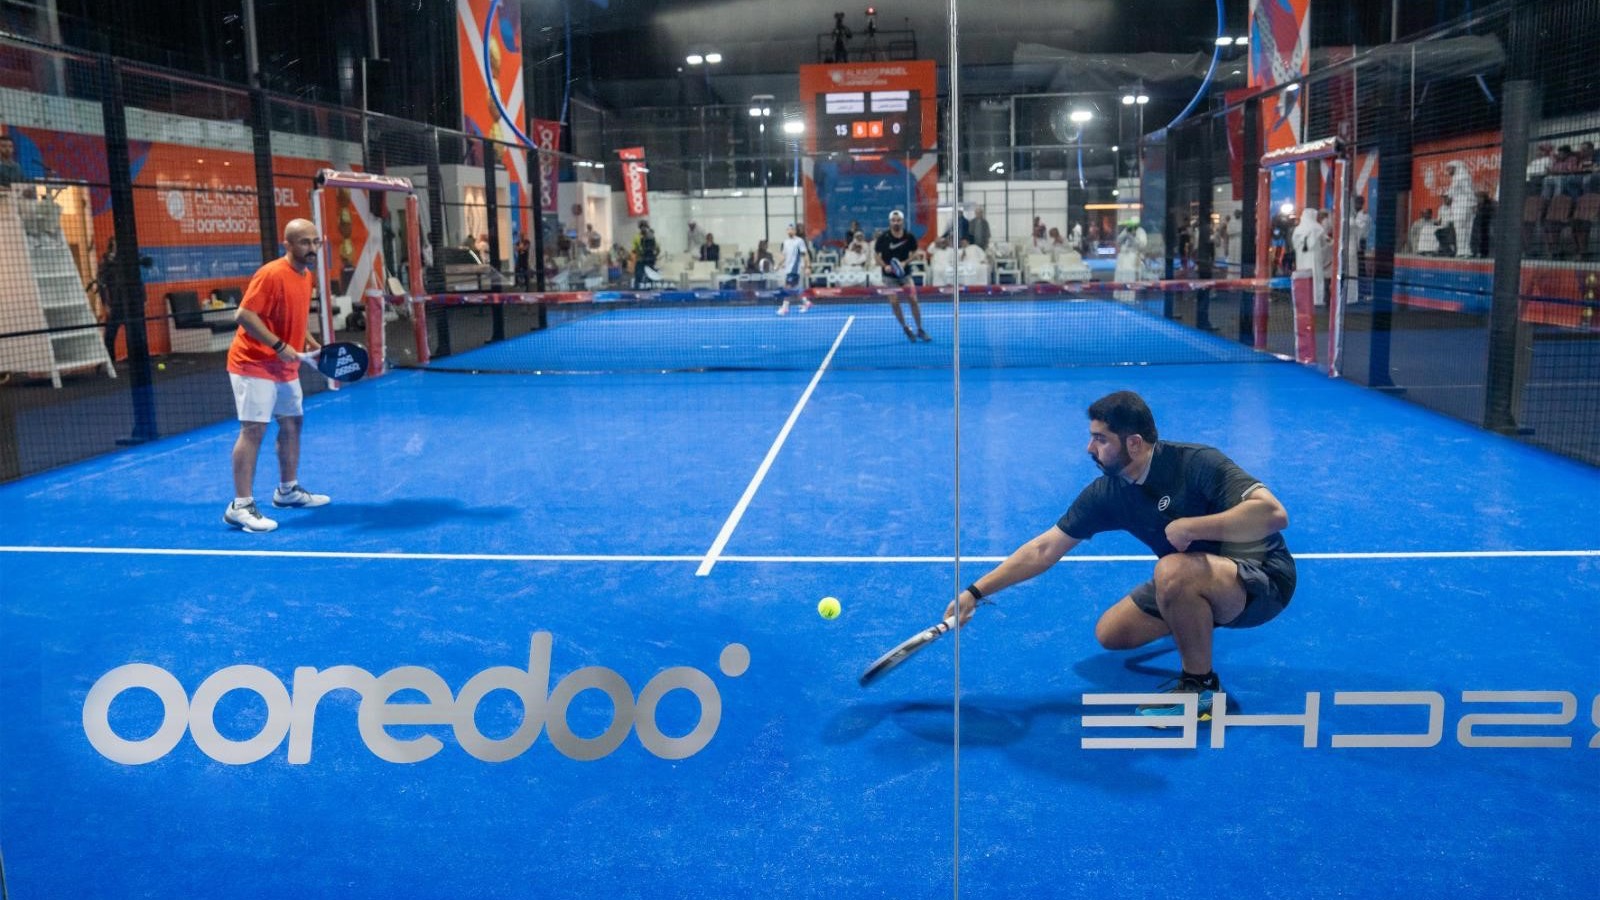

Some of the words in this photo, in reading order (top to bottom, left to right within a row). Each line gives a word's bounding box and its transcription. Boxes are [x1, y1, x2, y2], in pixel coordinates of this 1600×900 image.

[835, 124, 848, 136] 15
[892, 122, 900, 134] 0
[540, 128, 553, 206] ooredoo
[198, 217, 247, 233] ooredoo
[82, 631, 751, 764] ooredoo
